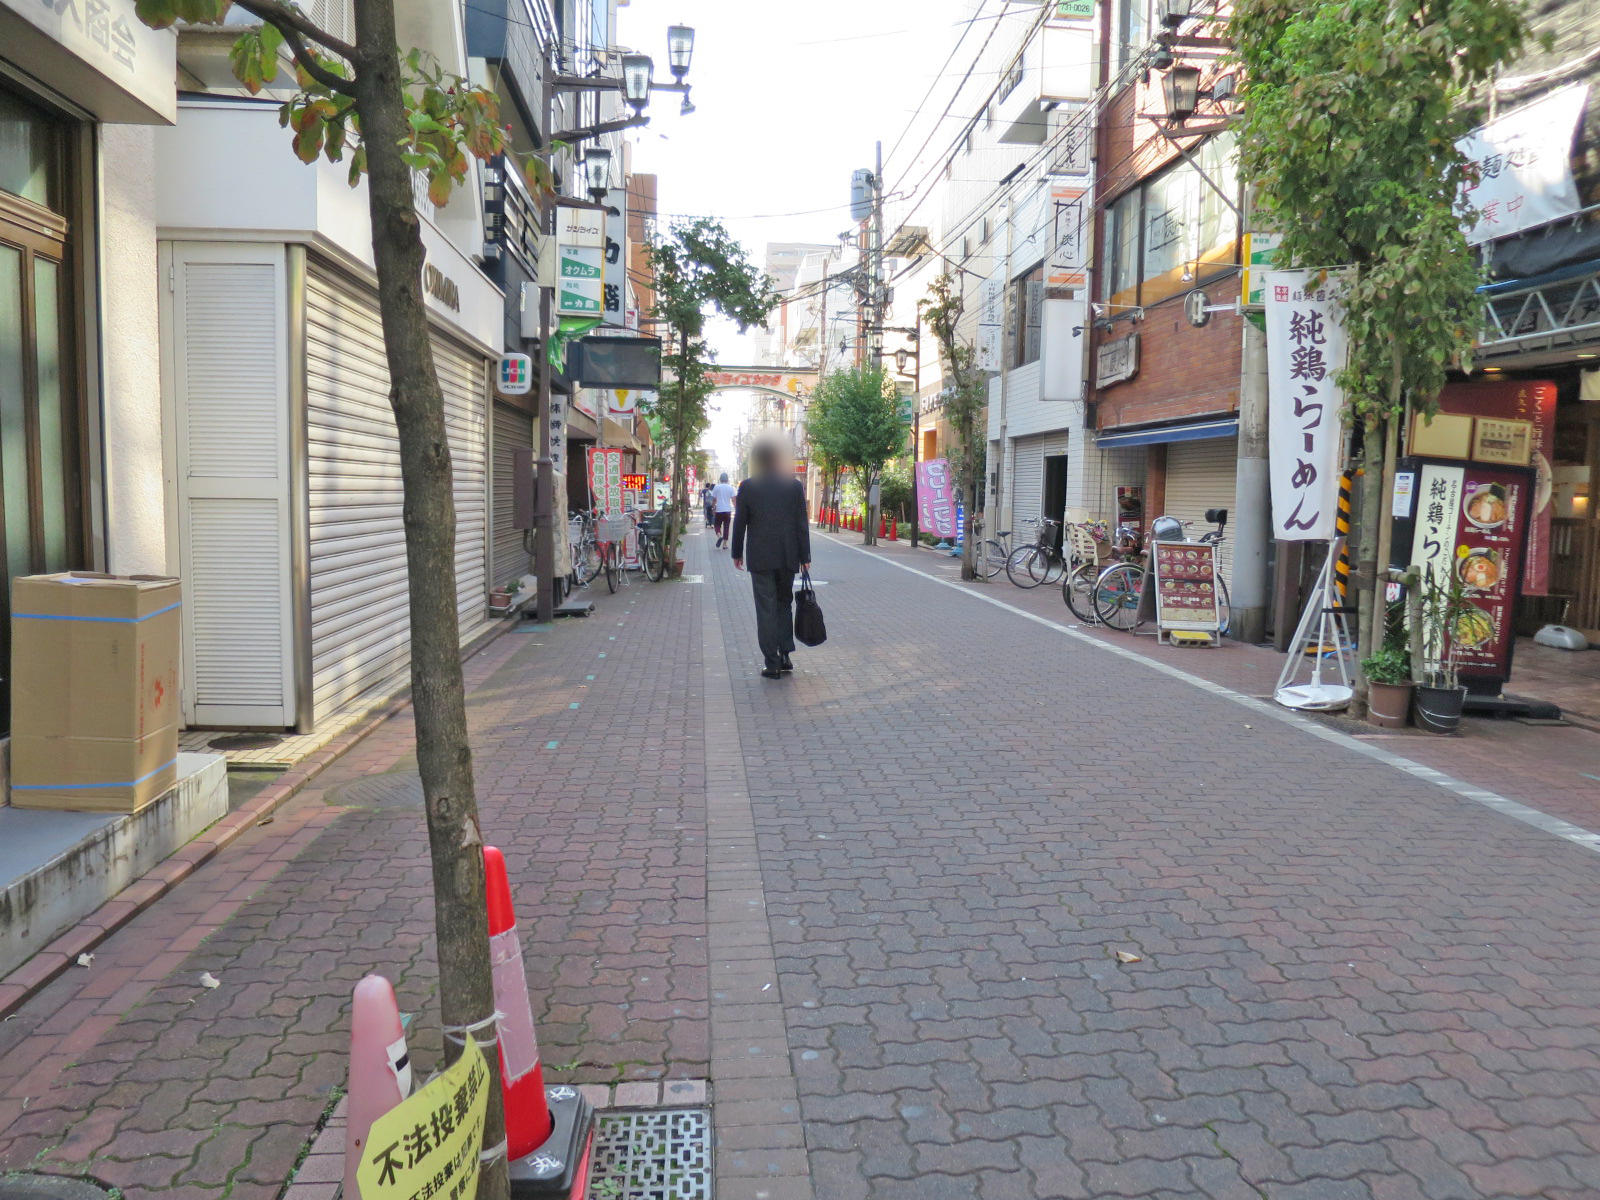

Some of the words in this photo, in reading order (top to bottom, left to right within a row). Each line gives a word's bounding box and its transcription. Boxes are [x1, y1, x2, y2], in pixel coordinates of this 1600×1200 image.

[566, 225, 599, 235] サンライズ
[565, 265, 595, 276] オクムラ
[502, 367, 525, 375] JCB
[1284, 308, 1327, 531] 純鶏らーめん
[593, 452, 606, 515] 各種保険取
[373, 1051, 485, 1186] 不法投棄禁止
